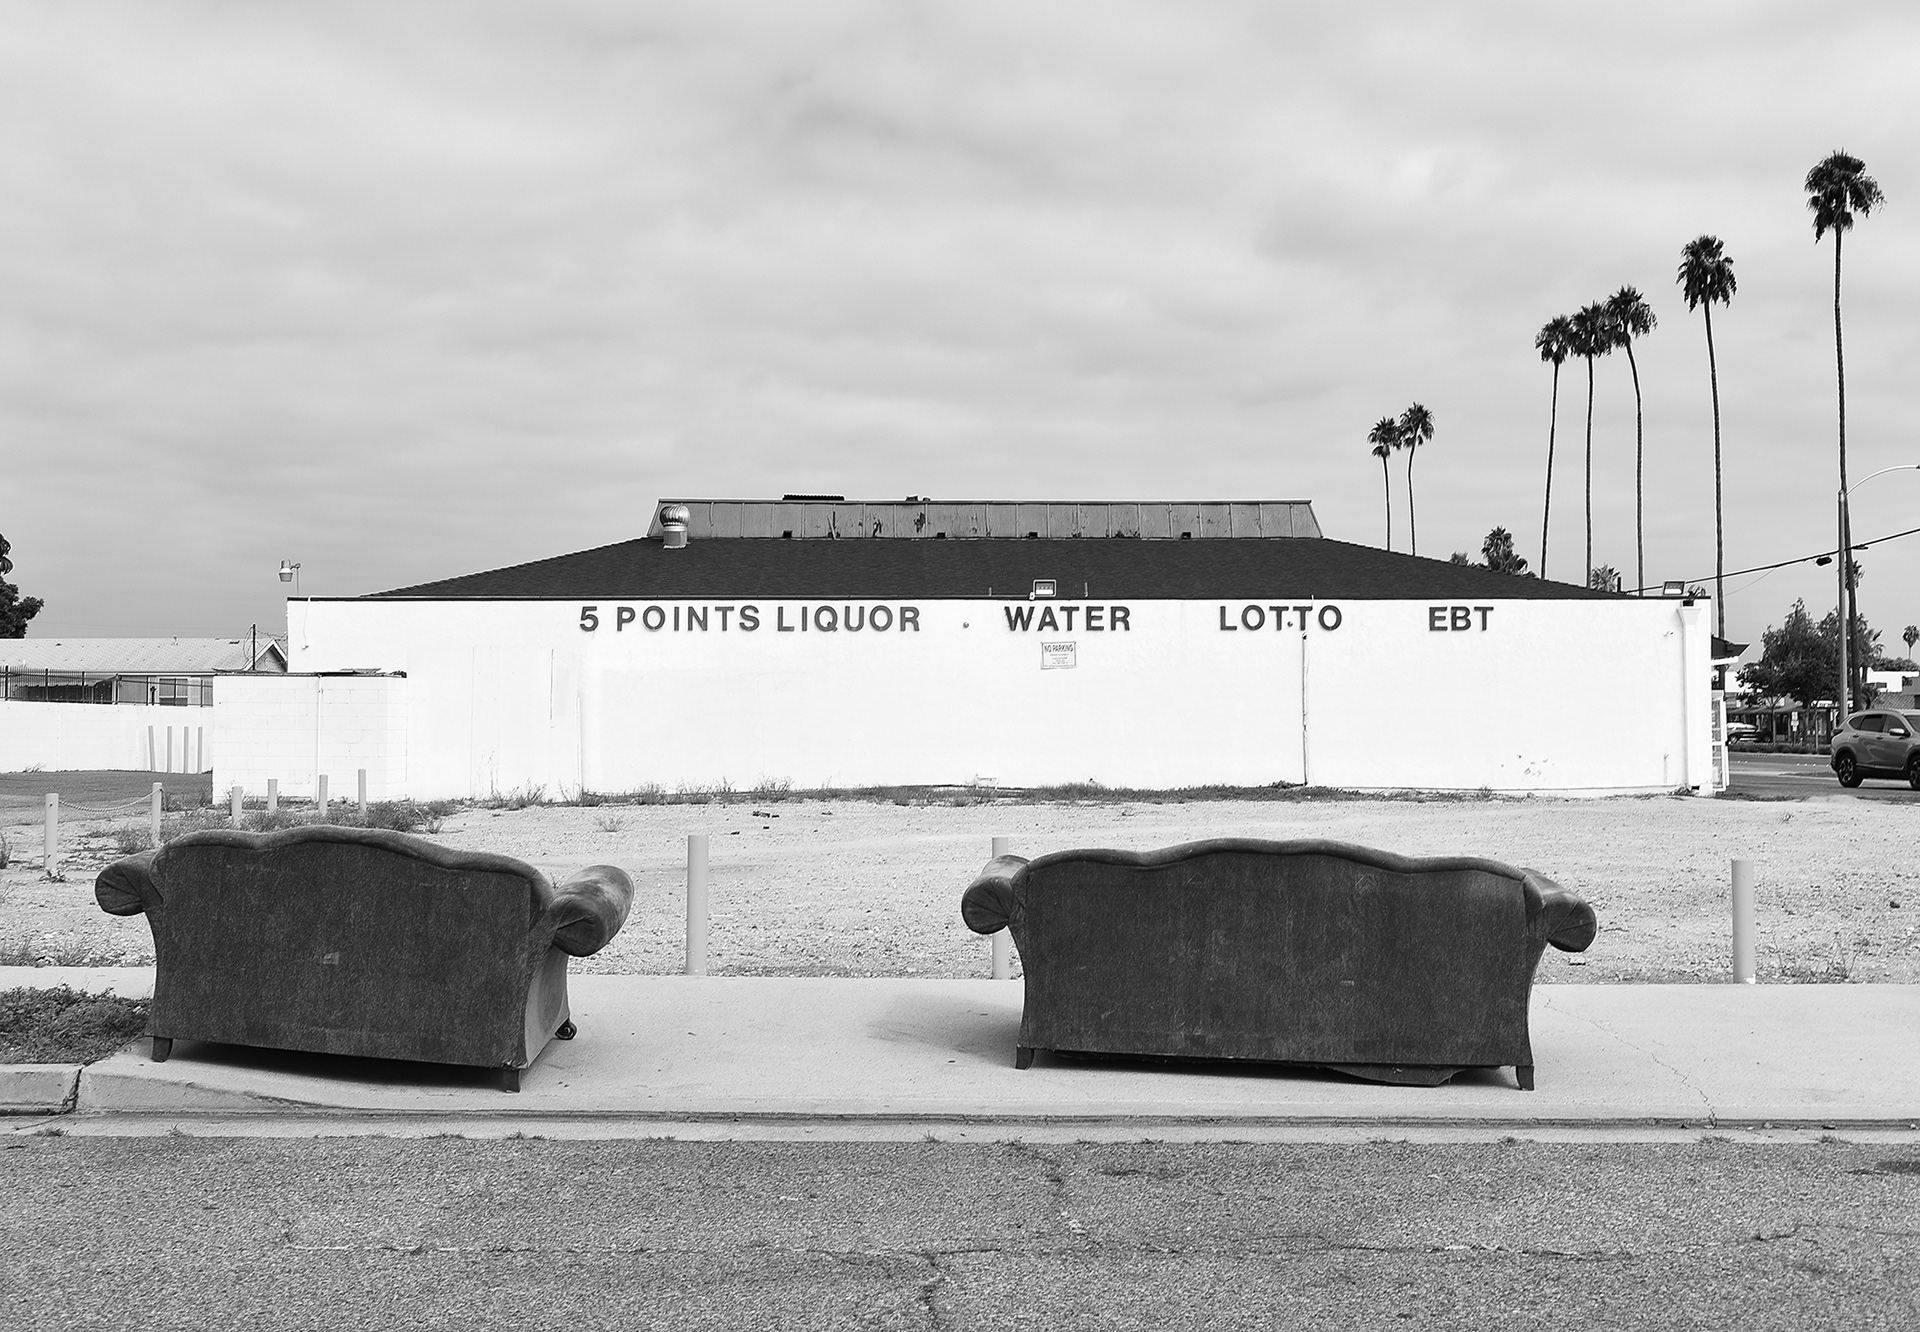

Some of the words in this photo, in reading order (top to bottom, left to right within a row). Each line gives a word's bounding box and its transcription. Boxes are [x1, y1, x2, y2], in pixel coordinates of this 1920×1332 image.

[579, 605, 599, 632] 5
[616, 605, 760, 632] POINTS
[777, 605, 920, 633] LIQUOR
[1003, 605, 1131, 632] WATER
[1219, 604, 1343, 632] LOTTO
[1428, 605, 1495, 632] EBT
[1044, 644, 1052, 653] NO
[1052, 644, 1074, 653] PARKING
